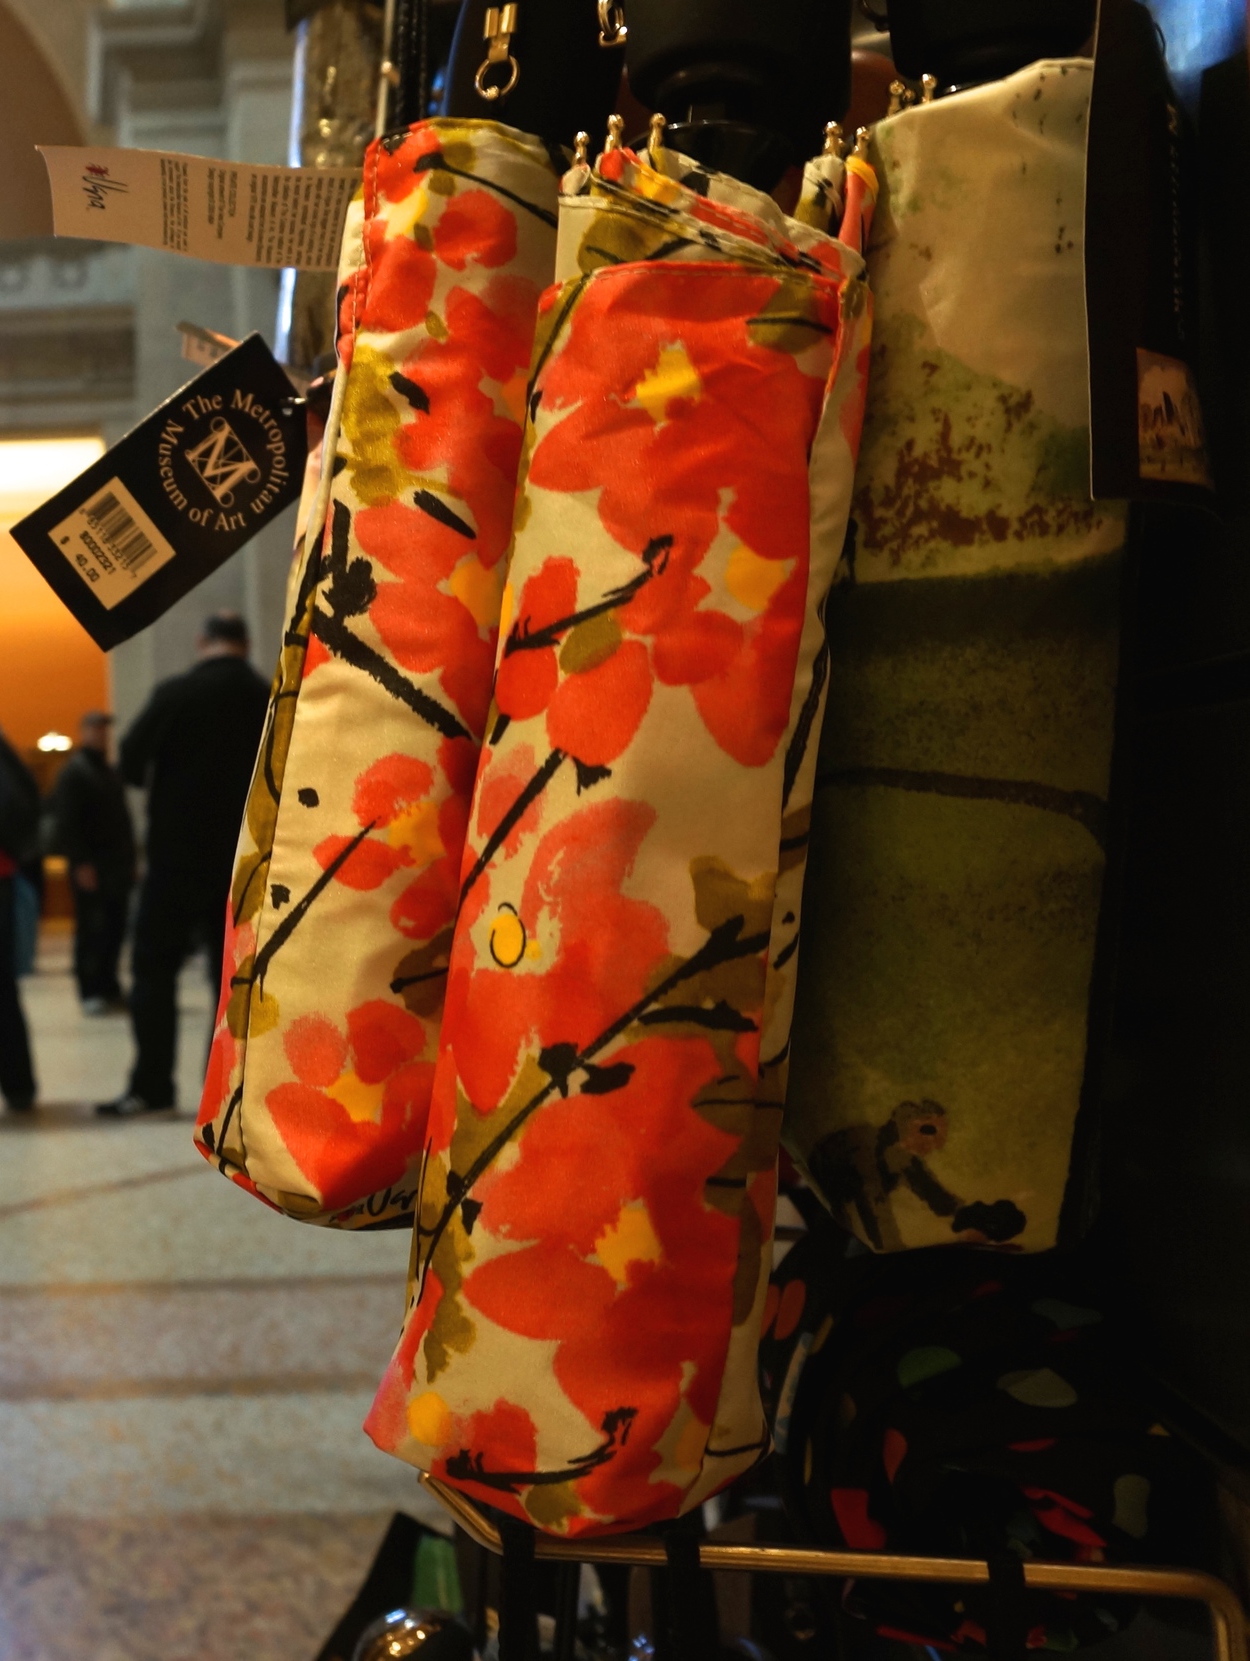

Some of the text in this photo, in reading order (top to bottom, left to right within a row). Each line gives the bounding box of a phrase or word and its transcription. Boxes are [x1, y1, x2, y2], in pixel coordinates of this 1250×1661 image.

[158, 419, 248, 532] Museum of Art
[182, 388, 290, 514] The Metropolitan
[74, 552, 101, 583] 40.00
